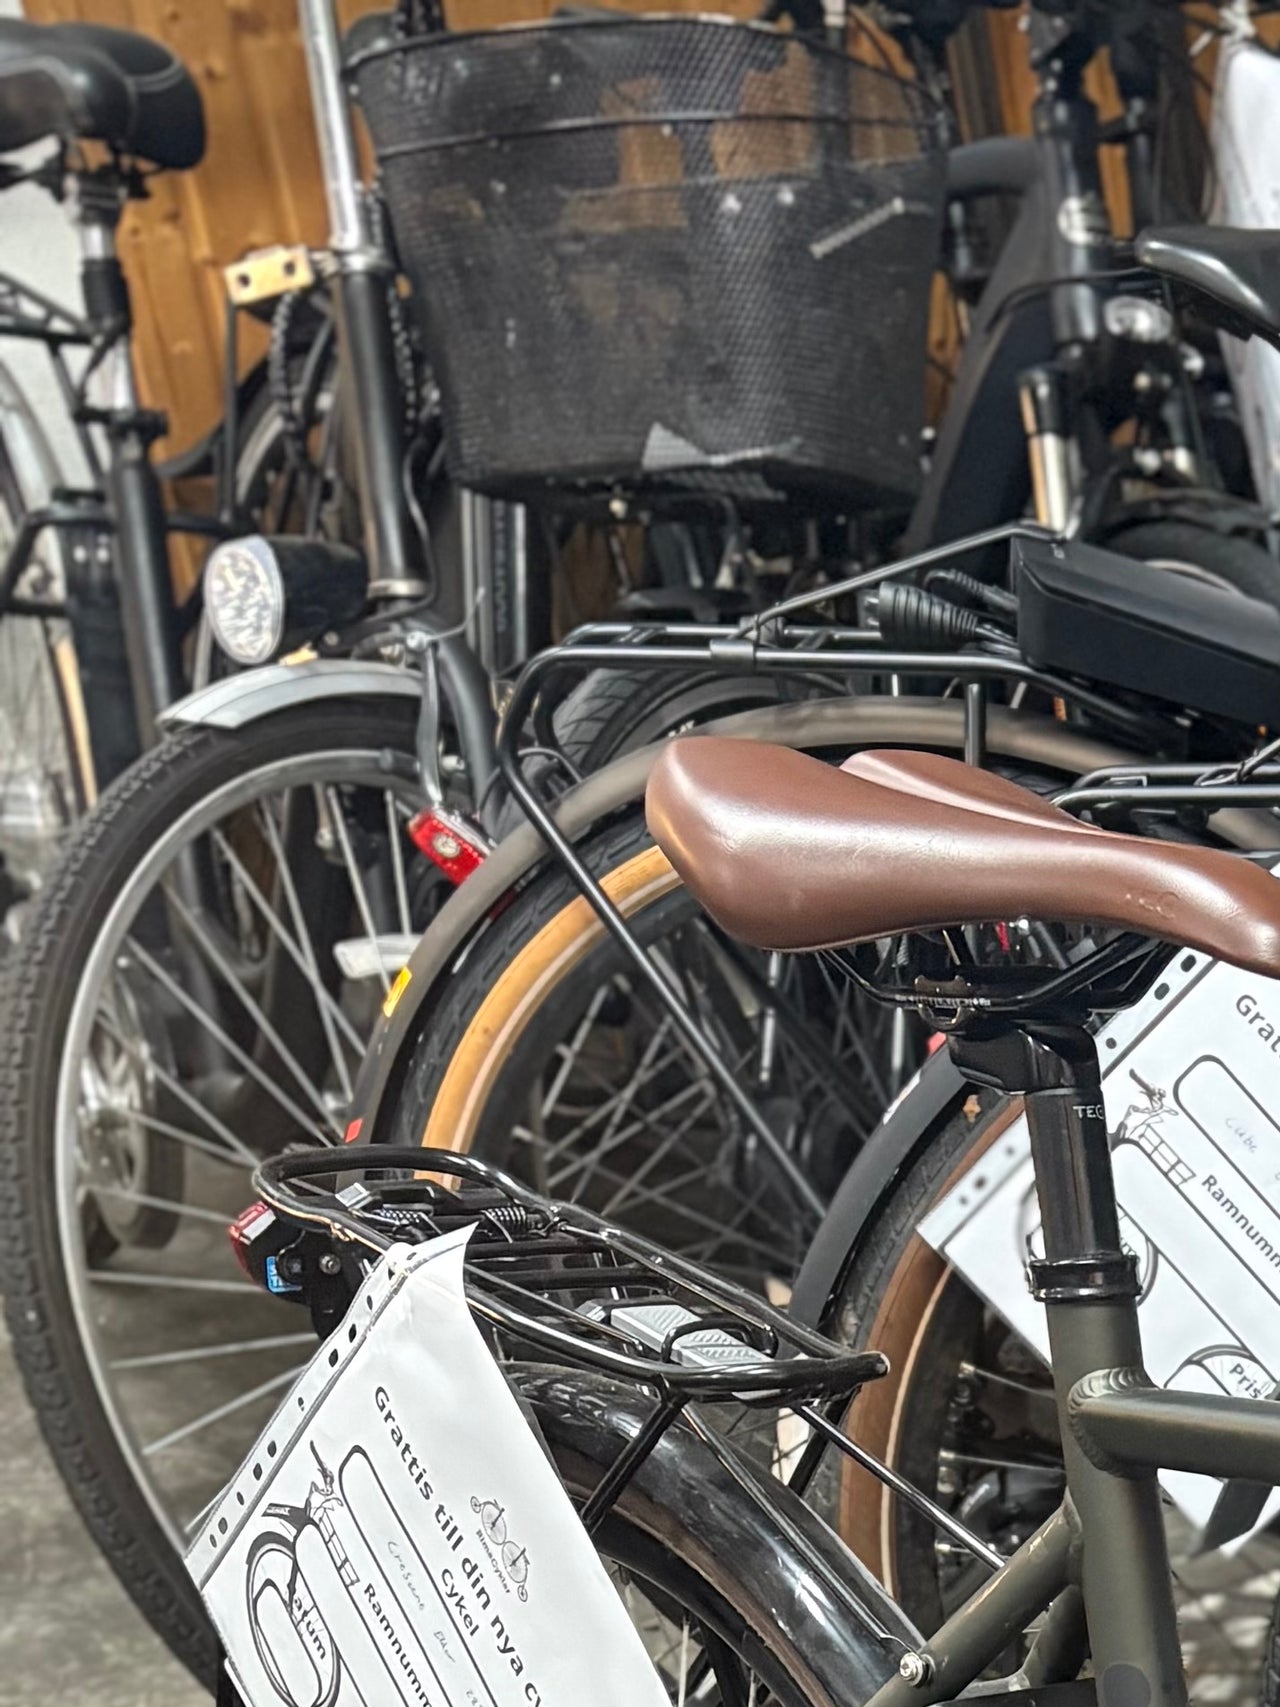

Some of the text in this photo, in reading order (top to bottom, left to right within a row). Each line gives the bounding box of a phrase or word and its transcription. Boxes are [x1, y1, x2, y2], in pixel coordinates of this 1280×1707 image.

[1229, 1362, 1262, 1399] Pris
[374, 1386, 434, 1502] Grattis
[433, 1503, 464, 1552] till
[462, 1556, 492, 1611] din
[490, 1614, 525, 1677] nya
[293, 1596, 327, 1661] atum
[441, 1568, 481, 1638] Cykel
